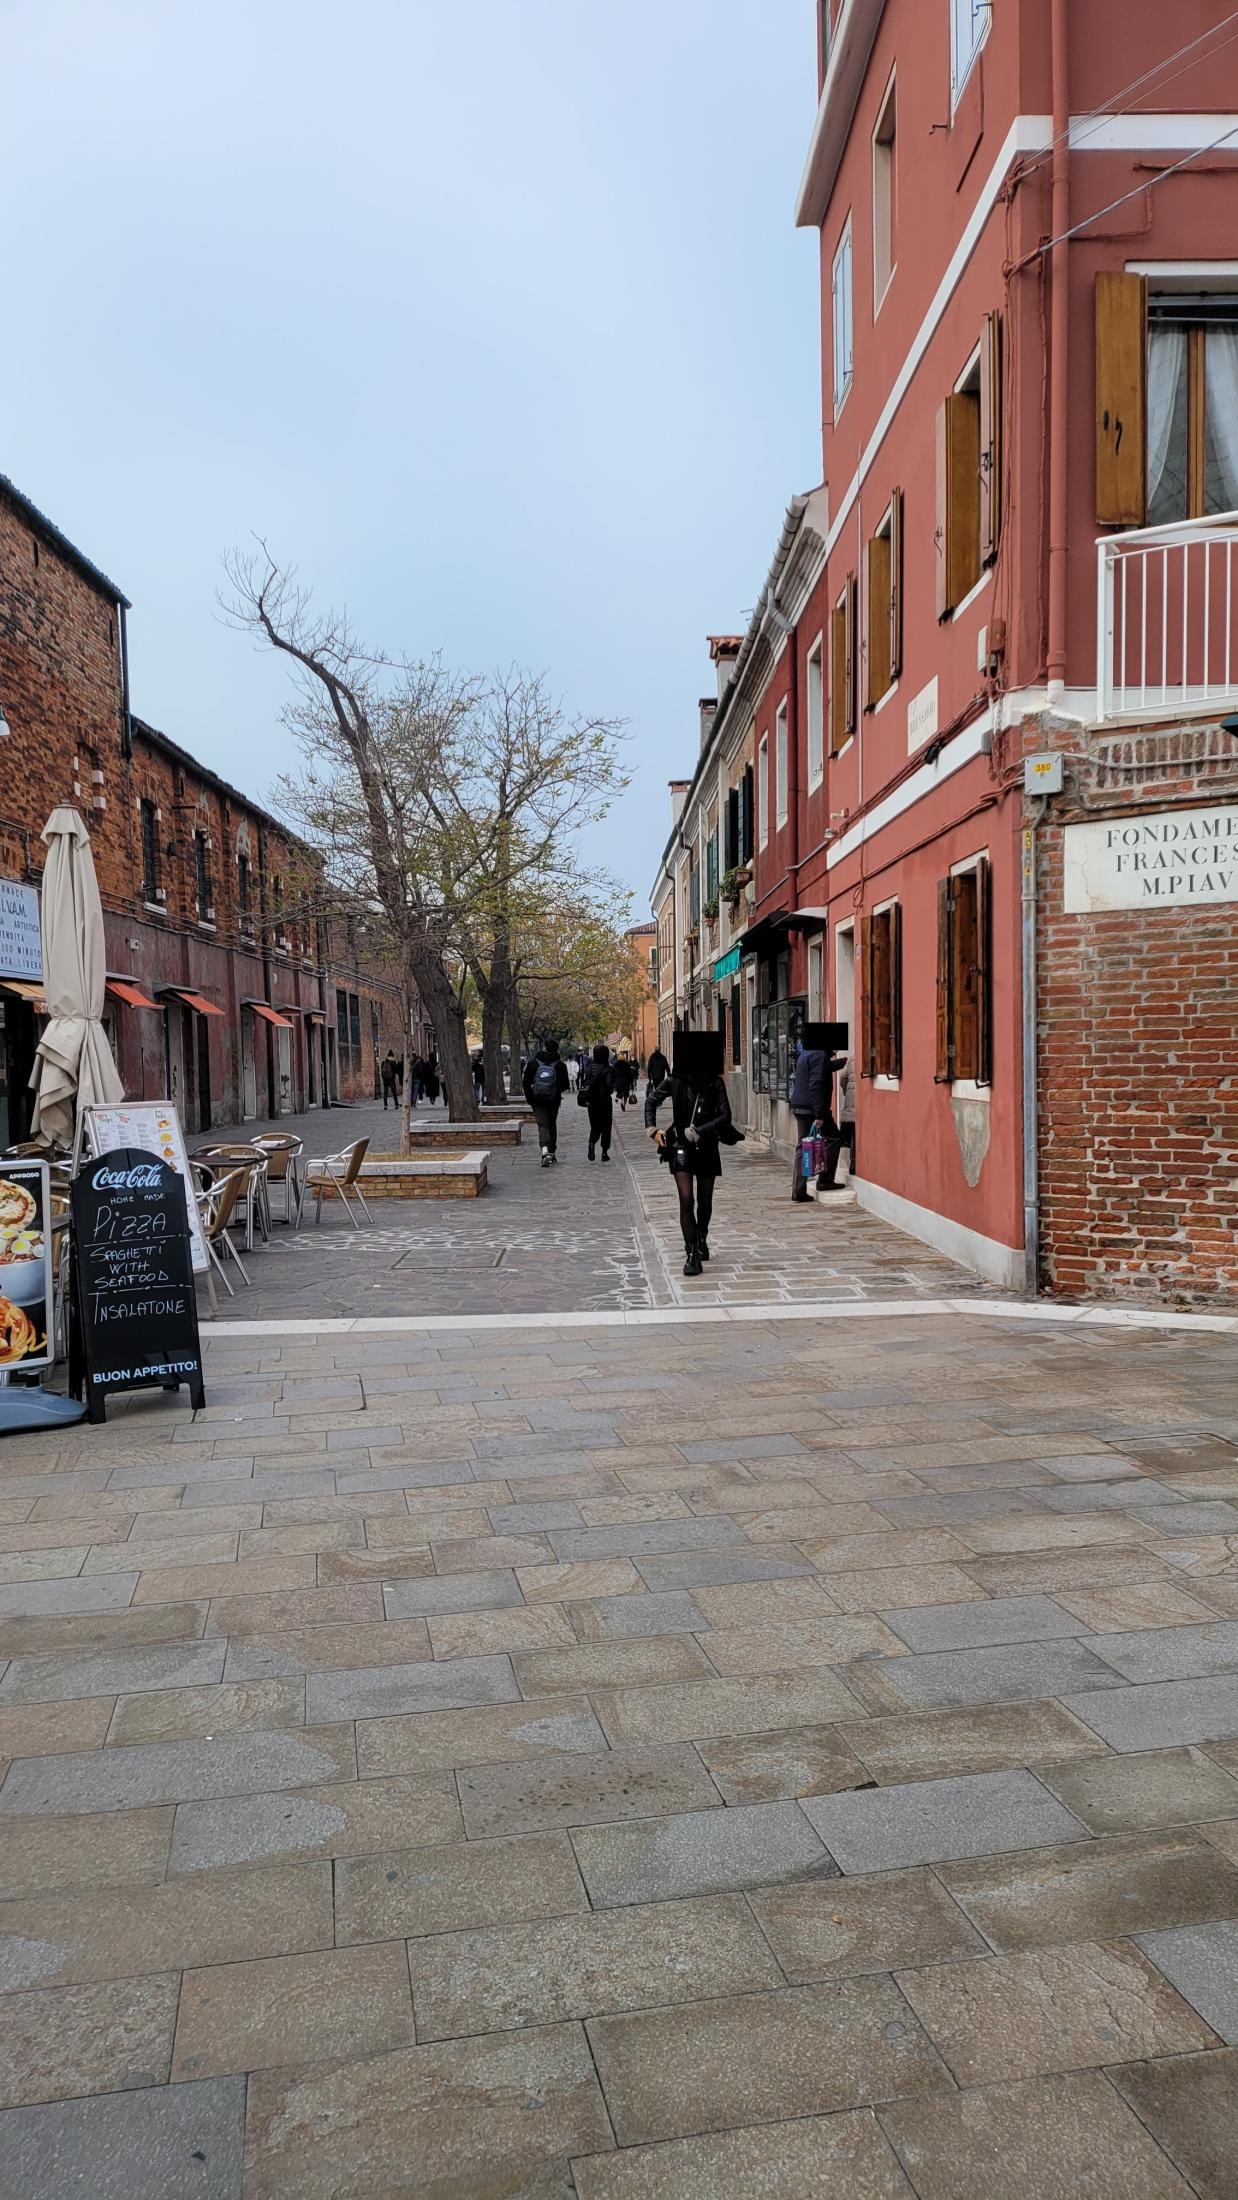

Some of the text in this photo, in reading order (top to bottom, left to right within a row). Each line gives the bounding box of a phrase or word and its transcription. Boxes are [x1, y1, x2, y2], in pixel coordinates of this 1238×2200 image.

[1106, 816, 1238, 848] FONDAME
[92, 1164, 164, 1190] Coca-Cola
[110, 1260, 150, 1274] WITH
[94, 1270, 169, 1288] SEAFOOD
[93, 1361, 198, 1384] BUON APPETITO!
